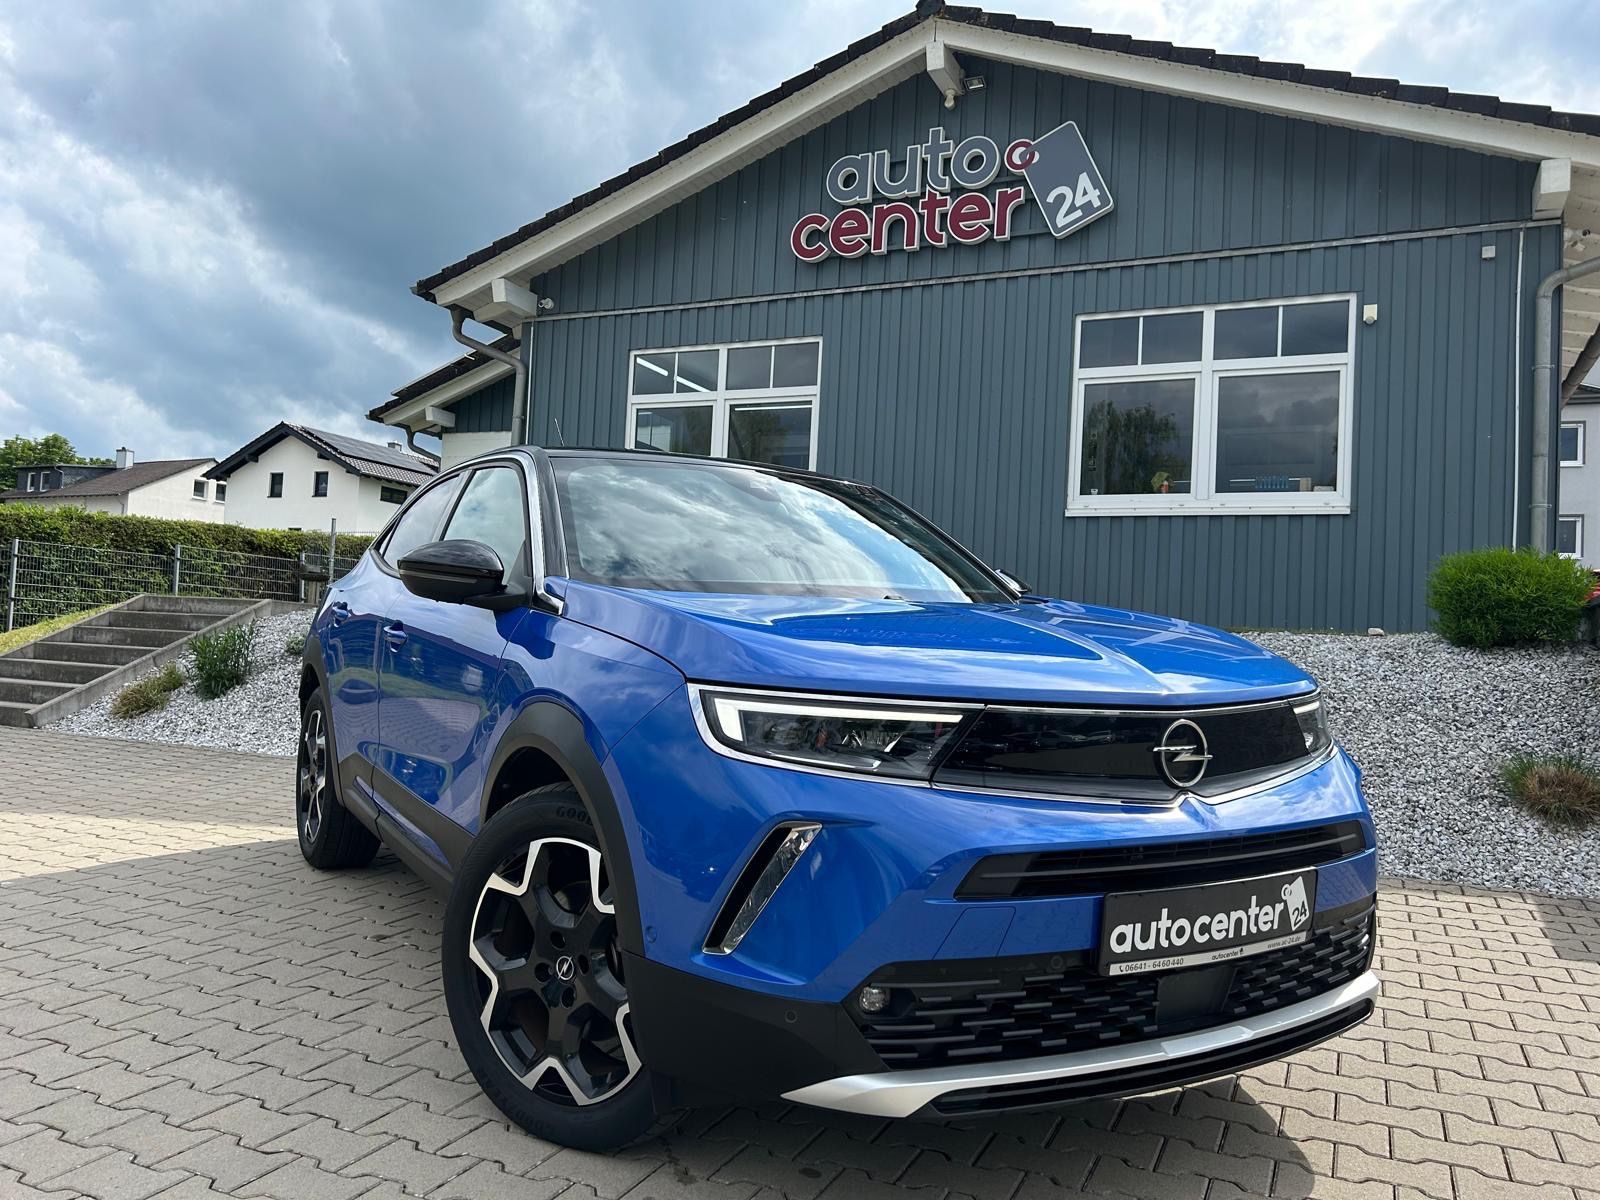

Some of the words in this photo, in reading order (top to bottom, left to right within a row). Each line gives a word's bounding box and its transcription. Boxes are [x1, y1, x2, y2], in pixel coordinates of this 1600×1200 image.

[826, 127, 1001, 206] auto
[790, 184, 1025, 263] center
[1046, 171, 1101, 229] 24
[1109, 895, 1285, 954] autocenter
[1291, 900, 1308, 927] 24
